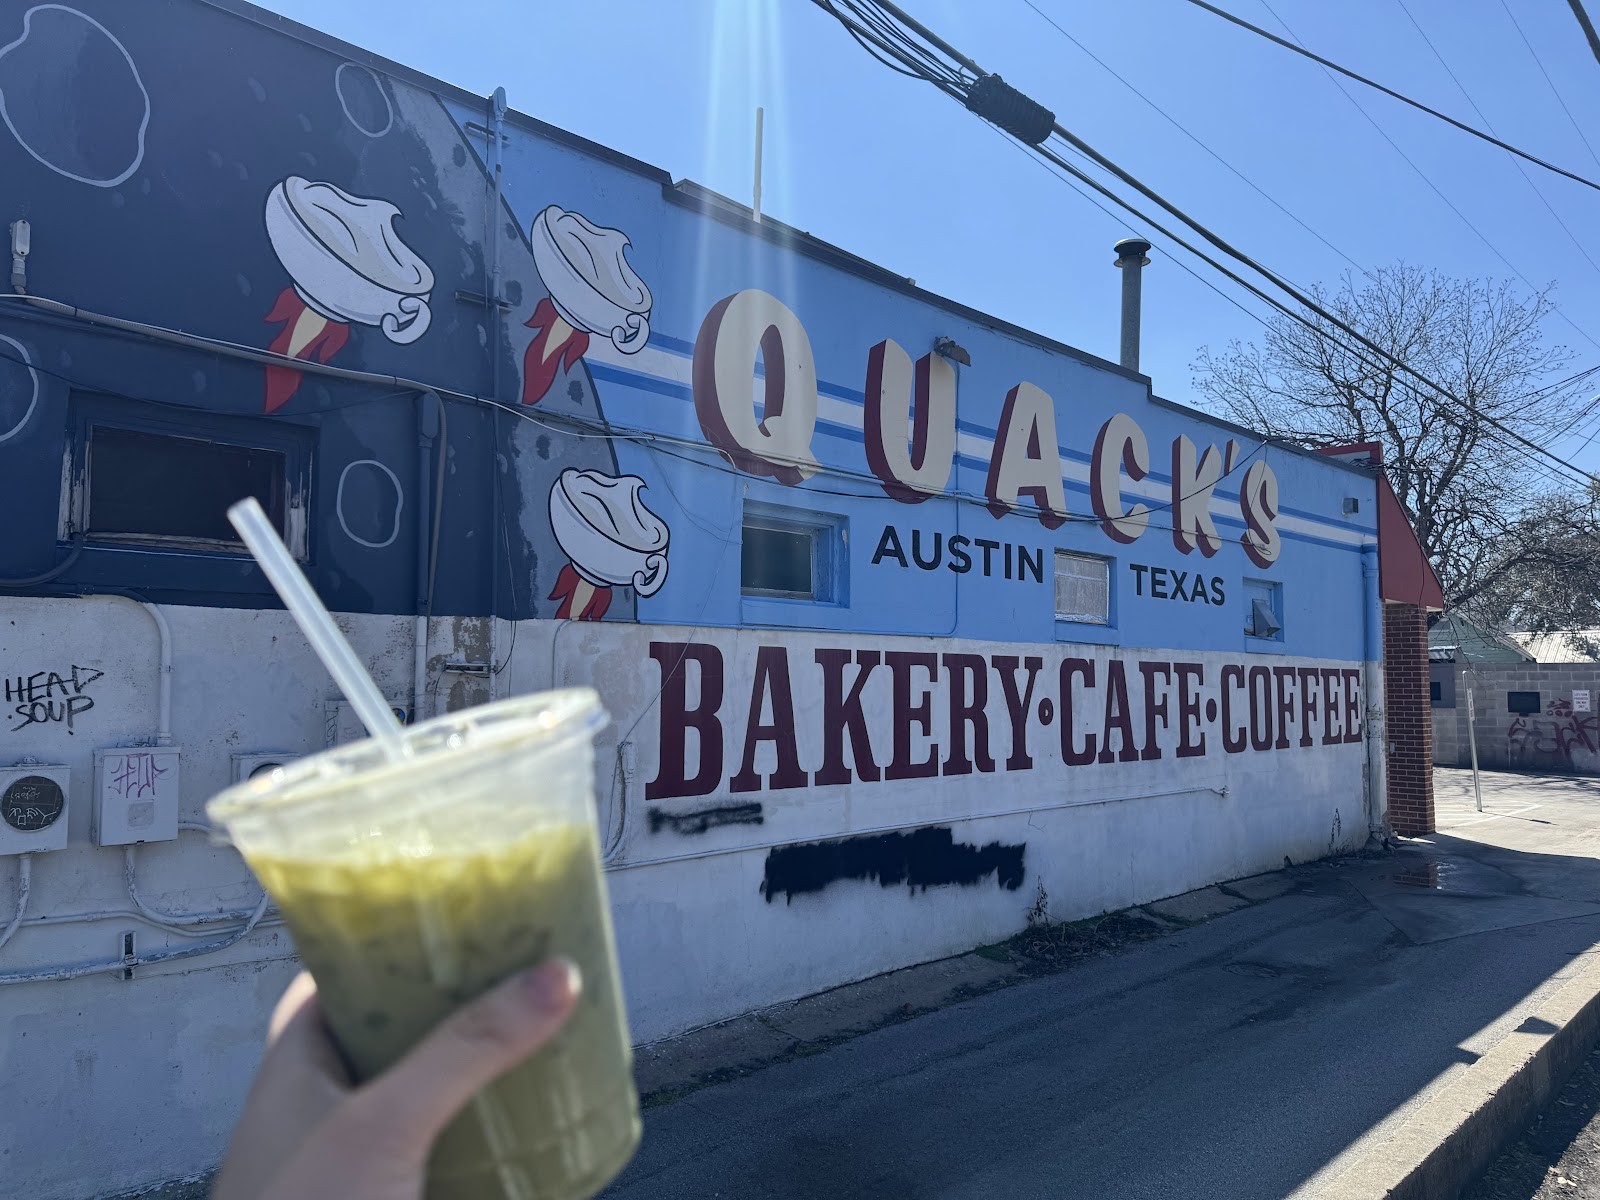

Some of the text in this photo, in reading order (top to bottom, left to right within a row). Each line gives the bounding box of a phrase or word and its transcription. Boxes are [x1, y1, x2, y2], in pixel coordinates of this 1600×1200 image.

[692, 288, 1282, 570] QUACK'S
[871, 525, 1226, 606] AUSTIN TEXAS
[645, 641, 1363, 800] BAKERY CAFE COFFEE
